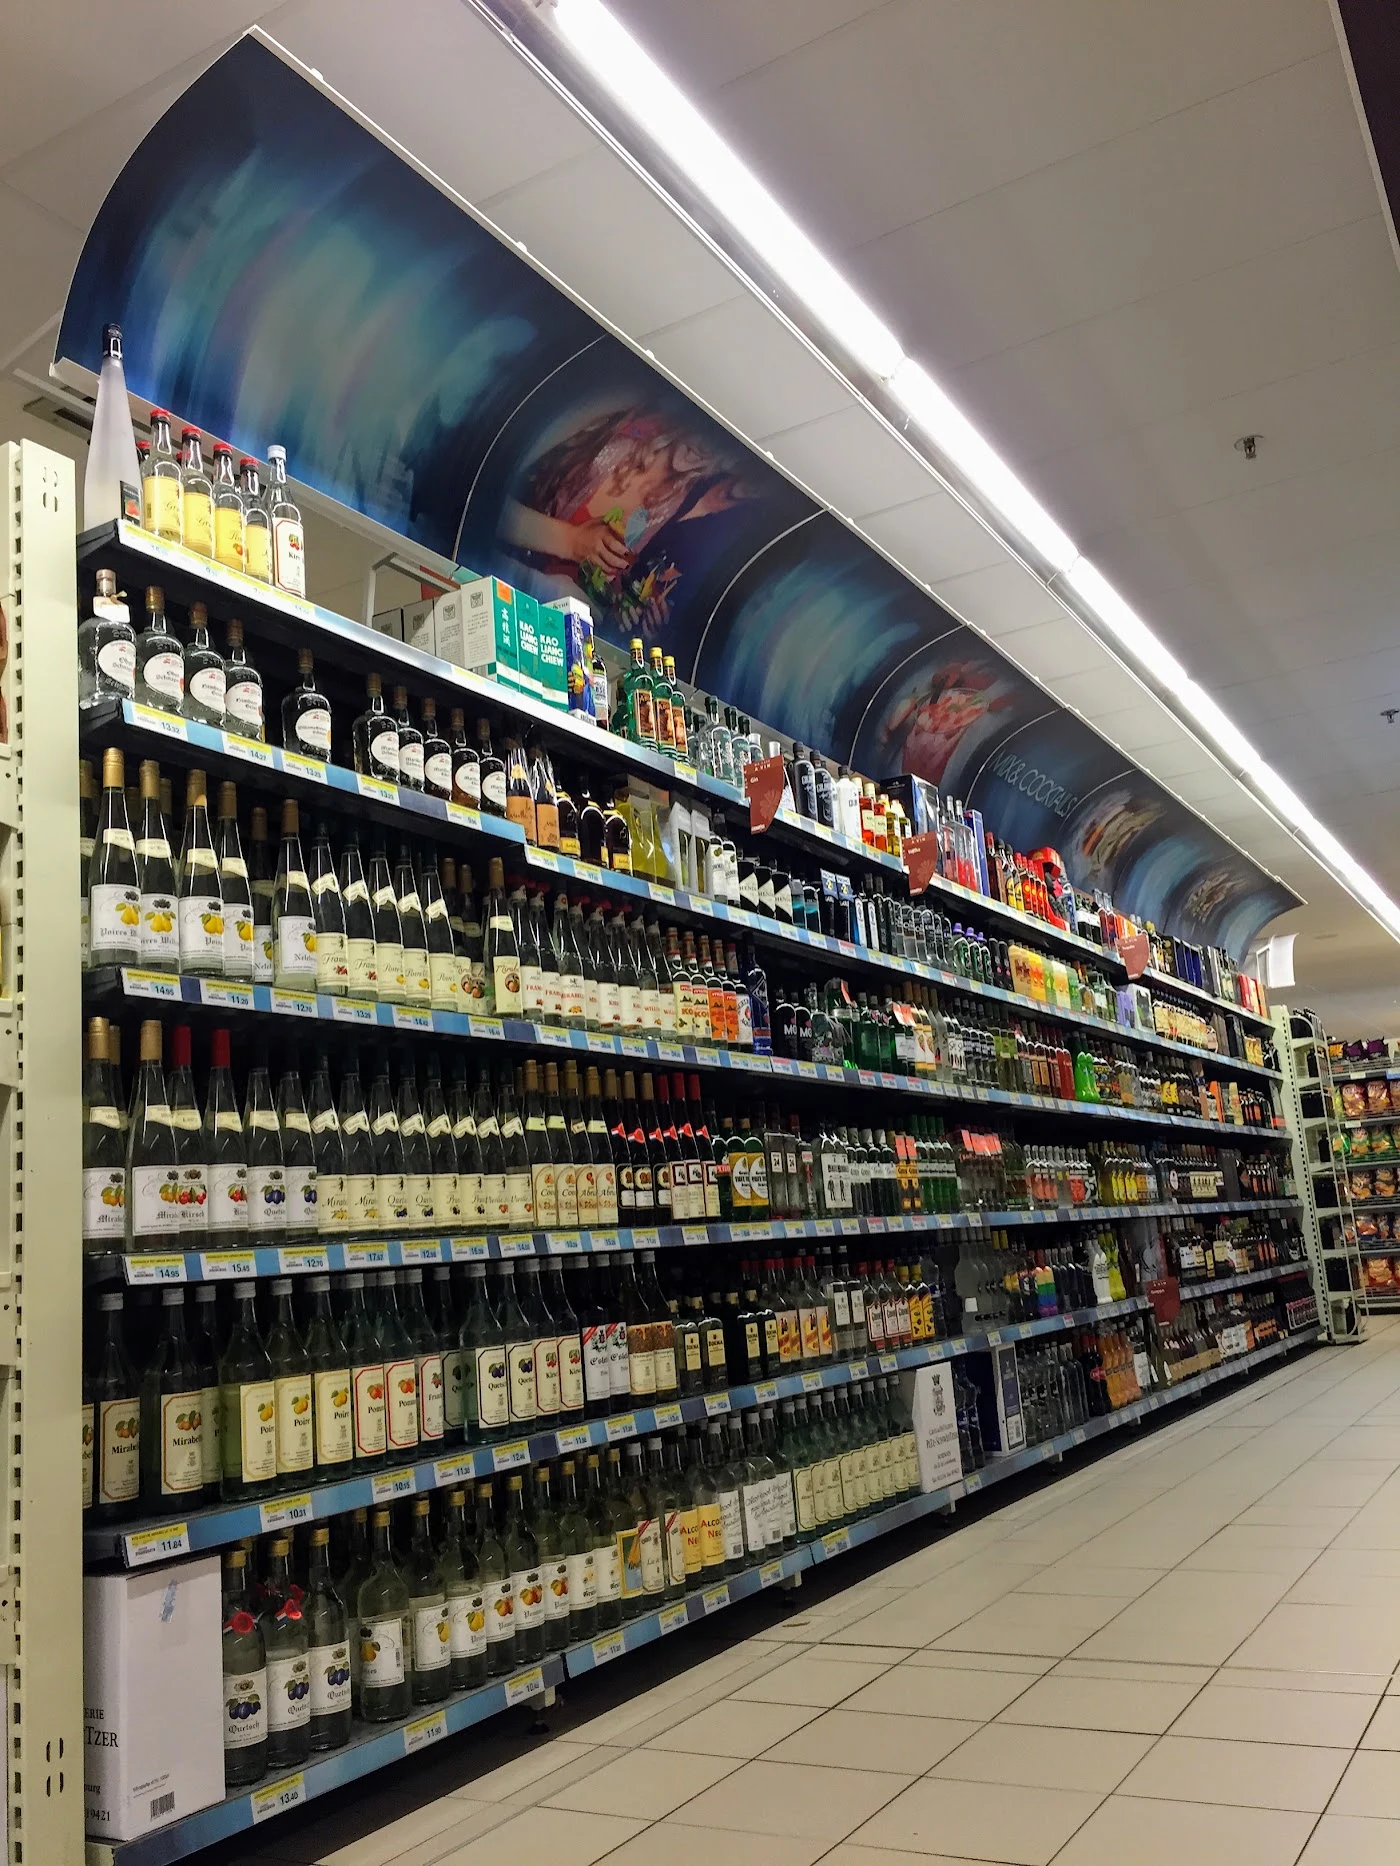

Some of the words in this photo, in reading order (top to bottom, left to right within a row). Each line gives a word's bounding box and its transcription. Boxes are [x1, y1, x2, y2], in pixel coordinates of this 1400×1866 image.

[519, 620, 534, 634] KAO
[519, 631, 539, 647] LIANG
[540, 634, 559, 647] KAO
[520, 641, 539, 656] CHIEW
[540, 643, 564, 658] LIANG
[541, 653, 564, 667] CHIEW
[1018, 769, 1078, 818] COCKTAILS
[159, 1269, 180, 1278] 14.95
